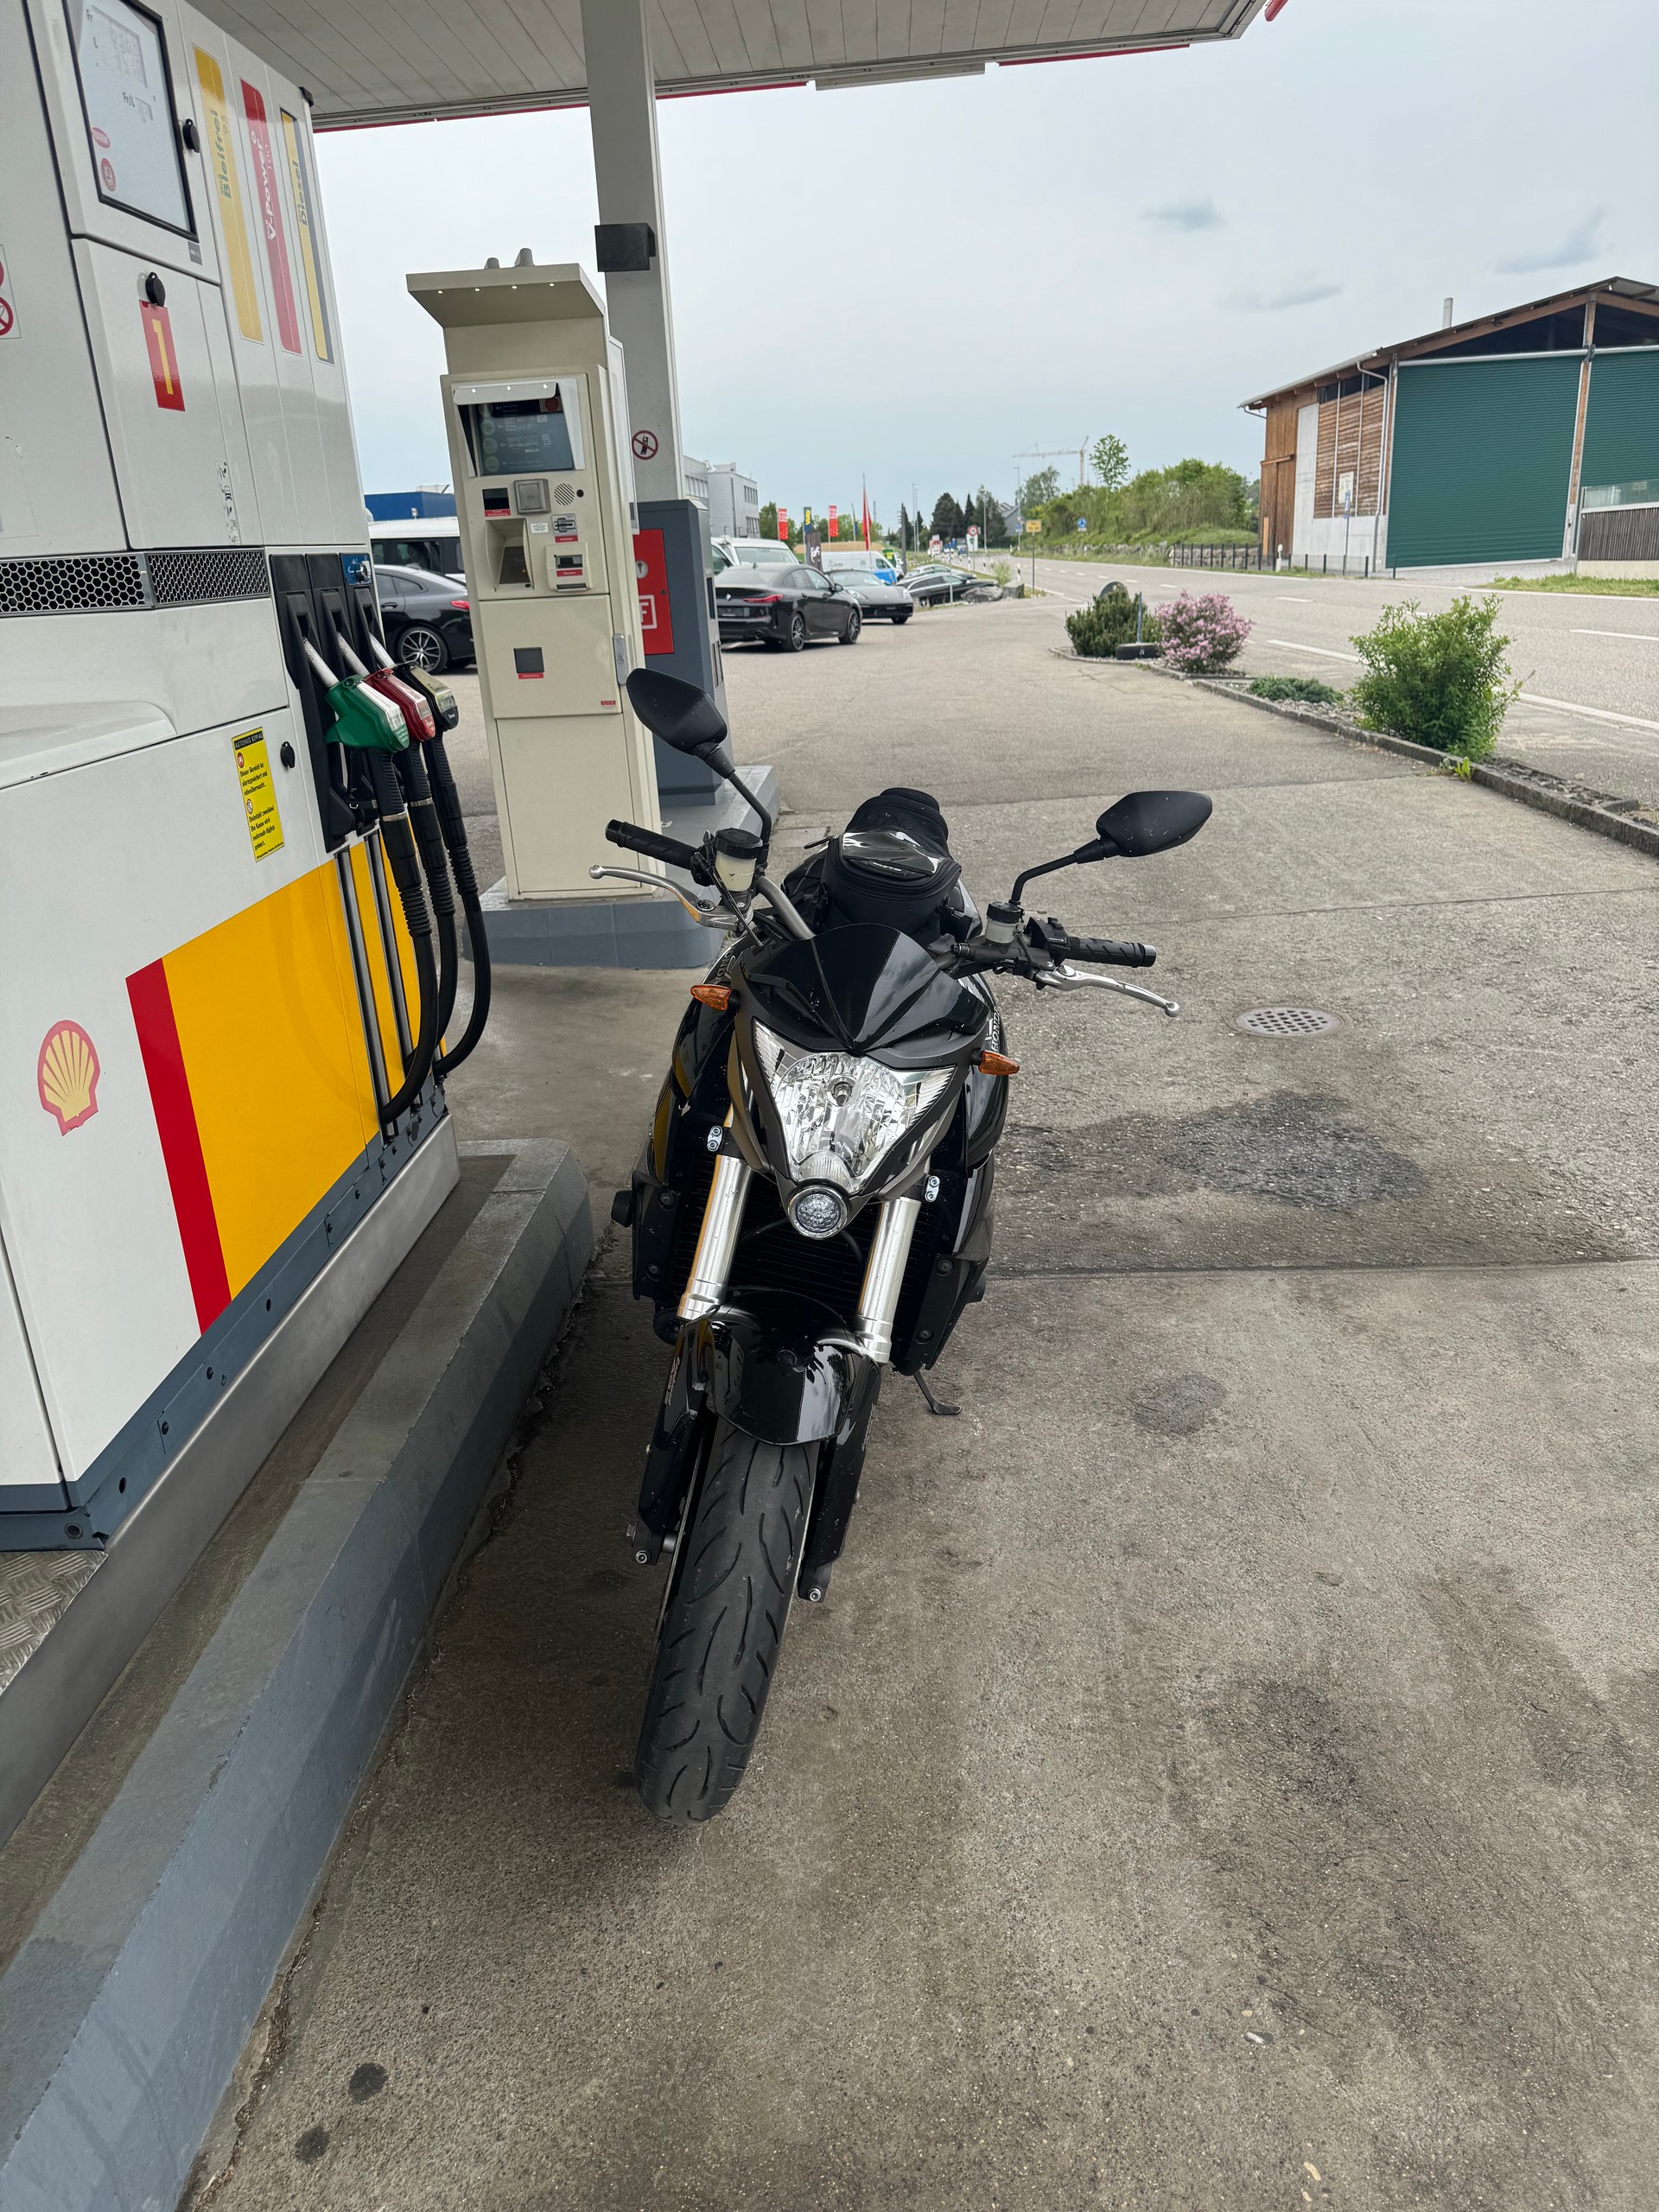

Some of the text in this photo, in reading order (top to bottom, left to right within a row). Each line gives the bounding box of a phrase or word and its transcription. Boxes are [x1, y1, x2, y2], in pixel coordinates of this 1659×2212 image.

[211, 109, 232, 199] Bleifrei
[257, 138, 276, 240] V-Power
[264, 144, 273, 169] 100
[292, 160, 308, 226] Diesel
[152, 319, 174, 395] 1
